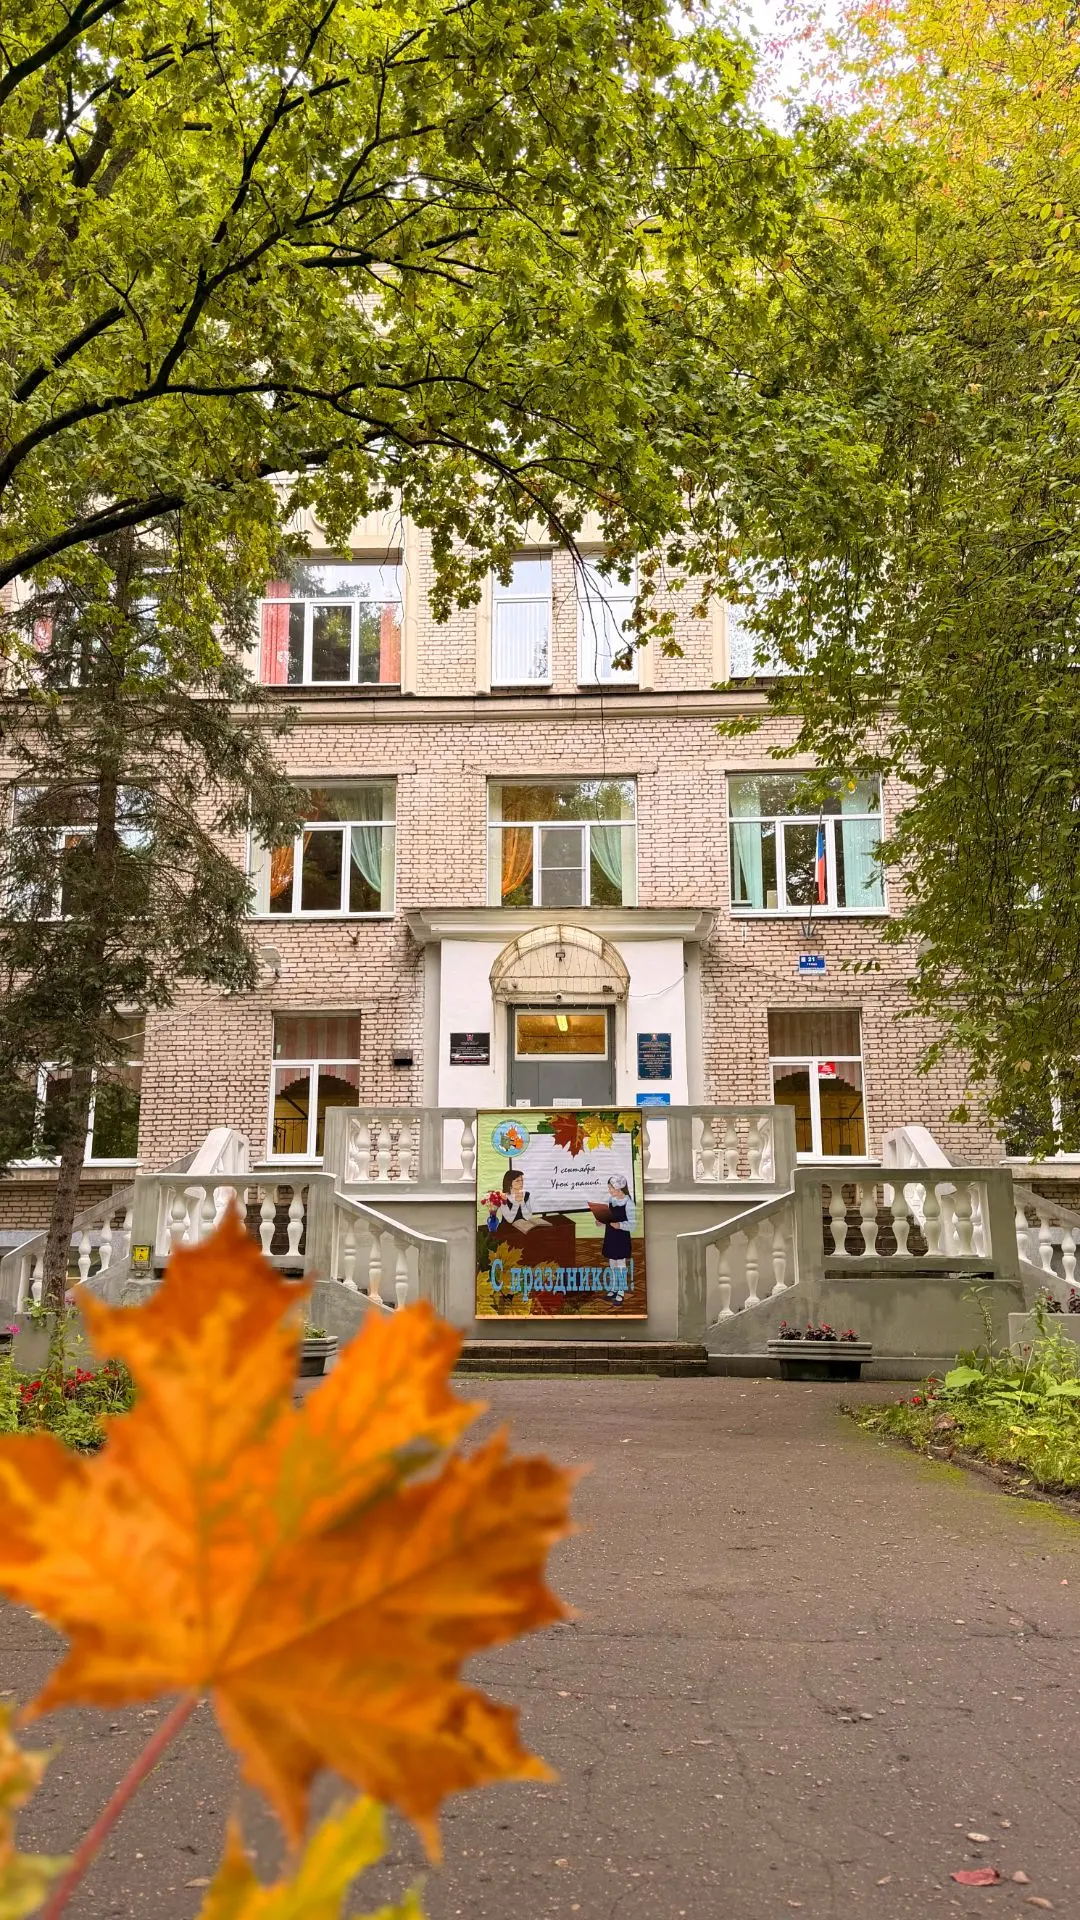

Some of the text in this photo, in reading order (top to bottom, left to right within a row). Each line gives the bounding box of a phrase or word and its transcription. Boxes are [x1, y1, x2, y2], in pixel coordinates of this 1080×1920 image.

[553, 1166, 558, 1175] 1
[550, 1178, 569, 1190] Урок
[490, 1257, 634, 1303] С праздником!
